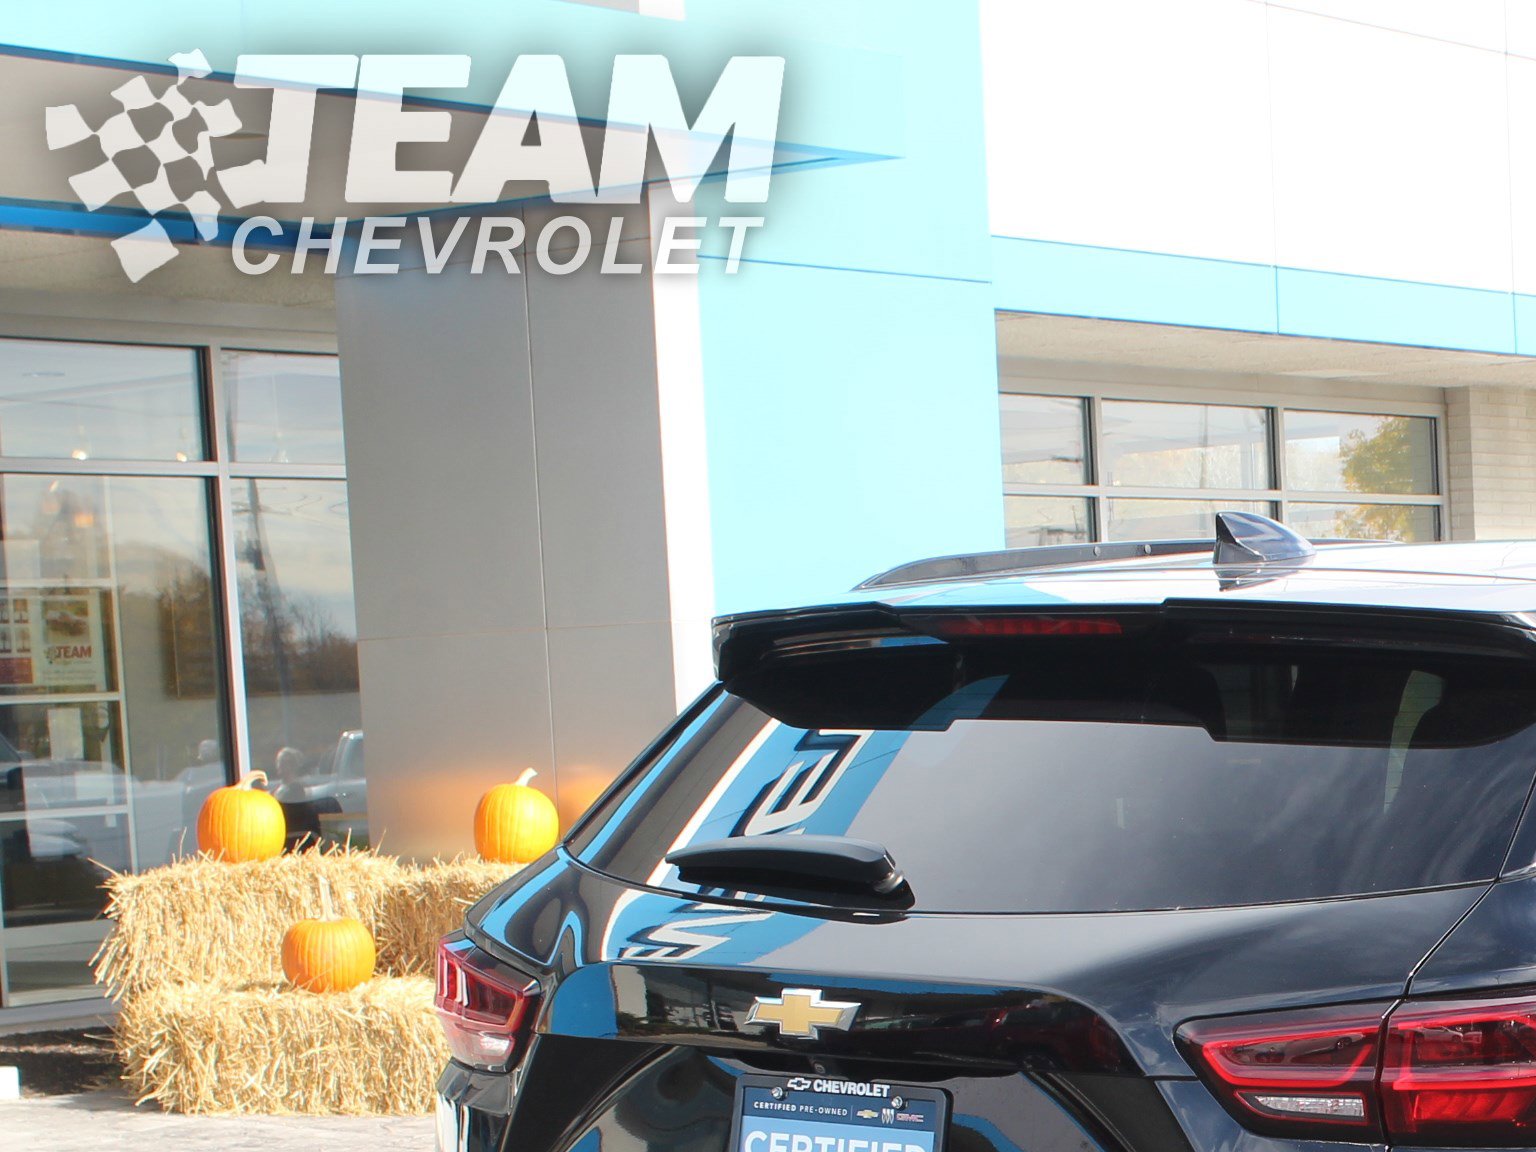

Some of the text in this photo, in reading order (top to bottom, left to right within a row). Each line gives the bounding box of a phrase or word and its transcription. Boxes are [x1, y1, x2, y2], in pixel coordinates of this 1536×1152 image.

[55, 645, 92, 659] TEAM
[813, 1078, 890, 1098] CHEVROLET
[753, 1101, 848, 1117] CERTIFIED PRE-OWNED
